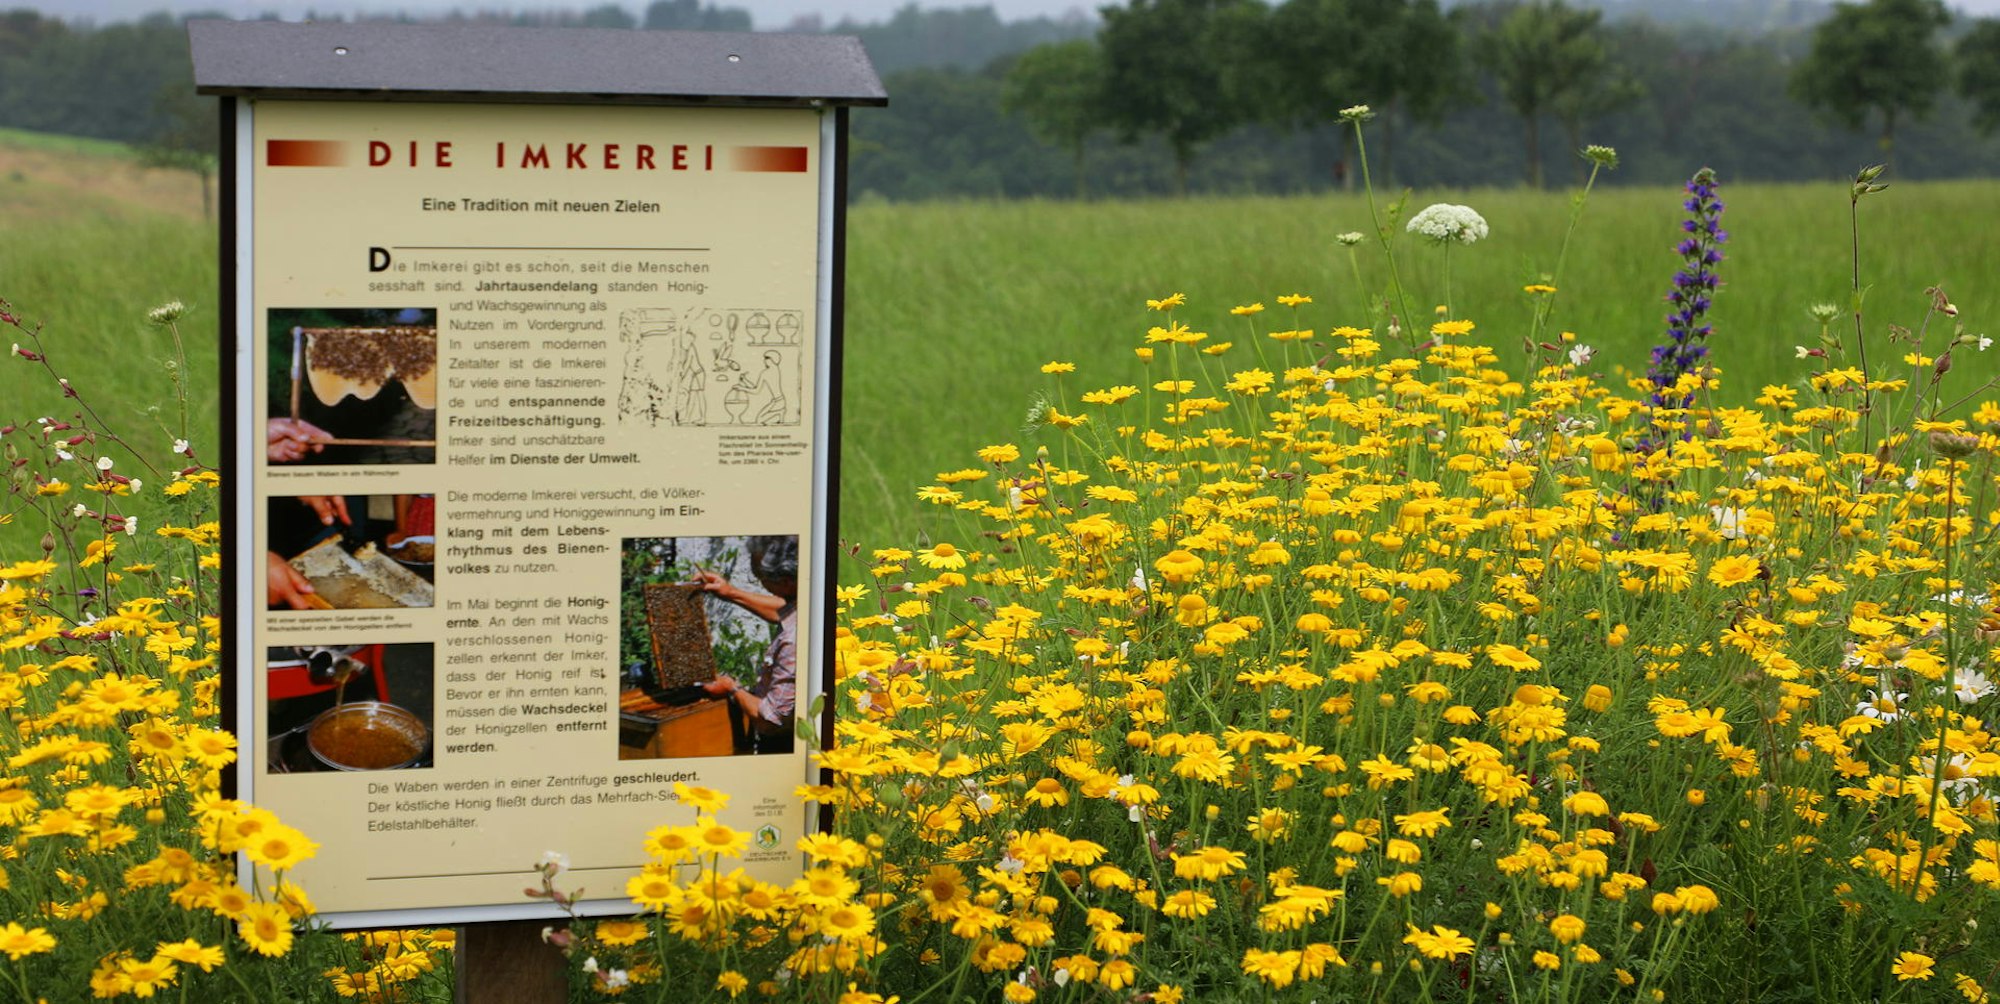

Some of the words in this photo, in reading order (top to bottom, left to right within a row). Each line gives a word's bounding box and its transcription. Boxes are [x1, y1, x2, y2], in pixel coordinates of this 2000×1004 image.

[368, 140, 452, 167] DIE
[496, 141, 712, 171] IMKEREI
[422, 197, 456, 211] Eine
[461, 198, 529, 212] Tradition
[534, 199, 558, 212] mit
[563, 201, 610, 212] neuen
[614, 199, 660, 213] Zielen
[370, 248, 406, 274] Die
[413, 260, 467, 272] Imkerei
[472, 261, 500, 275] gibt
[504, 263, 522, 273] es
[527, 261, 574, 273] schon,
[580, 262, 606, 273] seit
[610, 261, 632, 273] die
[637, 261, 709, 273] Menschen
[368, 280, 424, 291] sesshaft
[434, 281, 465, 291] sind.
[474, 280, 598, 294] Jahrtausendelang
[607, 282, 658, 292] standen
[667, 281, 708, 295] Honig-
[449, 300, 473, 311] und
[476, 299, 586, 314] Wachsgewinnung
[588, 300, 607, 311] als
[449, 319, 494, 331] Nutzen
[502, 321, 518, 330] im
[526, 319, 605, 333] Vordergrund.
[449, 338, 462, 349] In
[473, 340, 530, 350] unserem
[542, 338, 606, 350] modernen
[448, 357, 500, 369] Zeitalter
[509, 358, 523, 369] ist
[532, 358, 552, 369] die
[560, 357, 606, 369] Imkerei
[448, 377, 465, 389] für
[469, 377, 499, 389] viele
[503, 379, 530, 389] eine
[534, 376, 606, 388] faszinieren-
[448, 397, 464, 408] de
[475, 397, 499, 407] und
[508, 396, 605, 409] entspannende
[448, 415, 605, 429] Freizeitbeschäftigung.
[448, 435, 483, 446] Imker
[489, 434, 516, 446] sind
[522, 434, 605, 446] unschätzbare
[448, 454, 485, 465] Helfer
[489, 454, 506, 464] im
[510, 453, 560, 465] Dienste
[563, 453, 585, 464] der
[589, 452, 640, 464] Umwelt.
[447, 490, 468, 502] Die
[472, 490, 528, 502] moderne
[531, 489, 577, 501] Imkerei
[580, 488, 636, 500] versucht,
[639, 488, 658, 499] die
[661, 487, 705, 499] Völker-
[446, 509, 522, 522] vermehrung
[526, 508, 549, 519] und
[553, 507, 655, 521] Honiggewinnung
[659, 505, 675, 516] im
[679, 504, 705, 516] Ein-
[447, 527, 484, 541] klang
[491, 526, 512, 537] mit
[520, 526, 549, 537] dem
[557, 525, 610, 536] Lebens-
[447, 545, 513, 558] rhythmus
[522, 543, 547, 555] des
[557, 542, 609, 554] Bienen-
[446, 563, 490, 574] volkes
[494, 564, 509, 573] zu
[513, 563, 559, 573] nutzen.
[447, 599, 461, 609] Im
[467, 599, 489, 609] Mai
[495, 598, 538, 612] beginnt
[543, 597, 562, 608] die
[567, 596, 609, 610] Honig-
[446, 617, 481, 629] ernte.
[488, 616, 505, 626] An
[512, 616, 535, 627] den
[542, 616, 560, 625] mit
[567, 614, 608, 625] Wachs
[446, 634, 552, 646] verschlossenen
[564, 632, 608, 645] Honig-
[446, 653, 483, 665] zellen
[489, 651, 536, 663] erkennt
[543, 650, 564, 662] der
[571, 649, 607, 661] Imker,
[445, 671, 476, 682] dass
[485, 670, 506, 681] der
[515, 669, 552, 682] Honig
[561, 667, 581, 679] reif
[446, 688, 483, 700] Bevor
[487, 689, 500, 699] er
[505, 687, 524, 698] ihn
[529, 686, 569, 698] ernten
[574, 685, 607, 696] kann,
[446, 708, 494, 718] müssen
[498, 705, 517, 716] die
[521, 701, 607, 715] Wachsdeckel
[446, 725, 466, 736] der
[475, 722, 547, 736] Honigzellen
[555, 720, 607, 732] entfernt
[445, 741, 499, 753] werden.
[368, 782, 389, 794] Die
[394, 782, 438, 793] Waben
[443, 779, 489, 791] werden
[494, 780, 505, 788] in
[510, 779, 541, 788] einer
[546, 775, 607, 788] Zentrifuge
[613, 771, 700, 787] geschleudert.
[367, 801, 391, 813] Der
[395, 799, 450, 812] köstliche
[455, 798, 491, 811] Honig
[495, 795, 526, 807] fließt
[530, 794, 565, 806] durch
[569, 793, 592, 805] das
[367, 817, 477, 832] Edelstahlbehälter.
